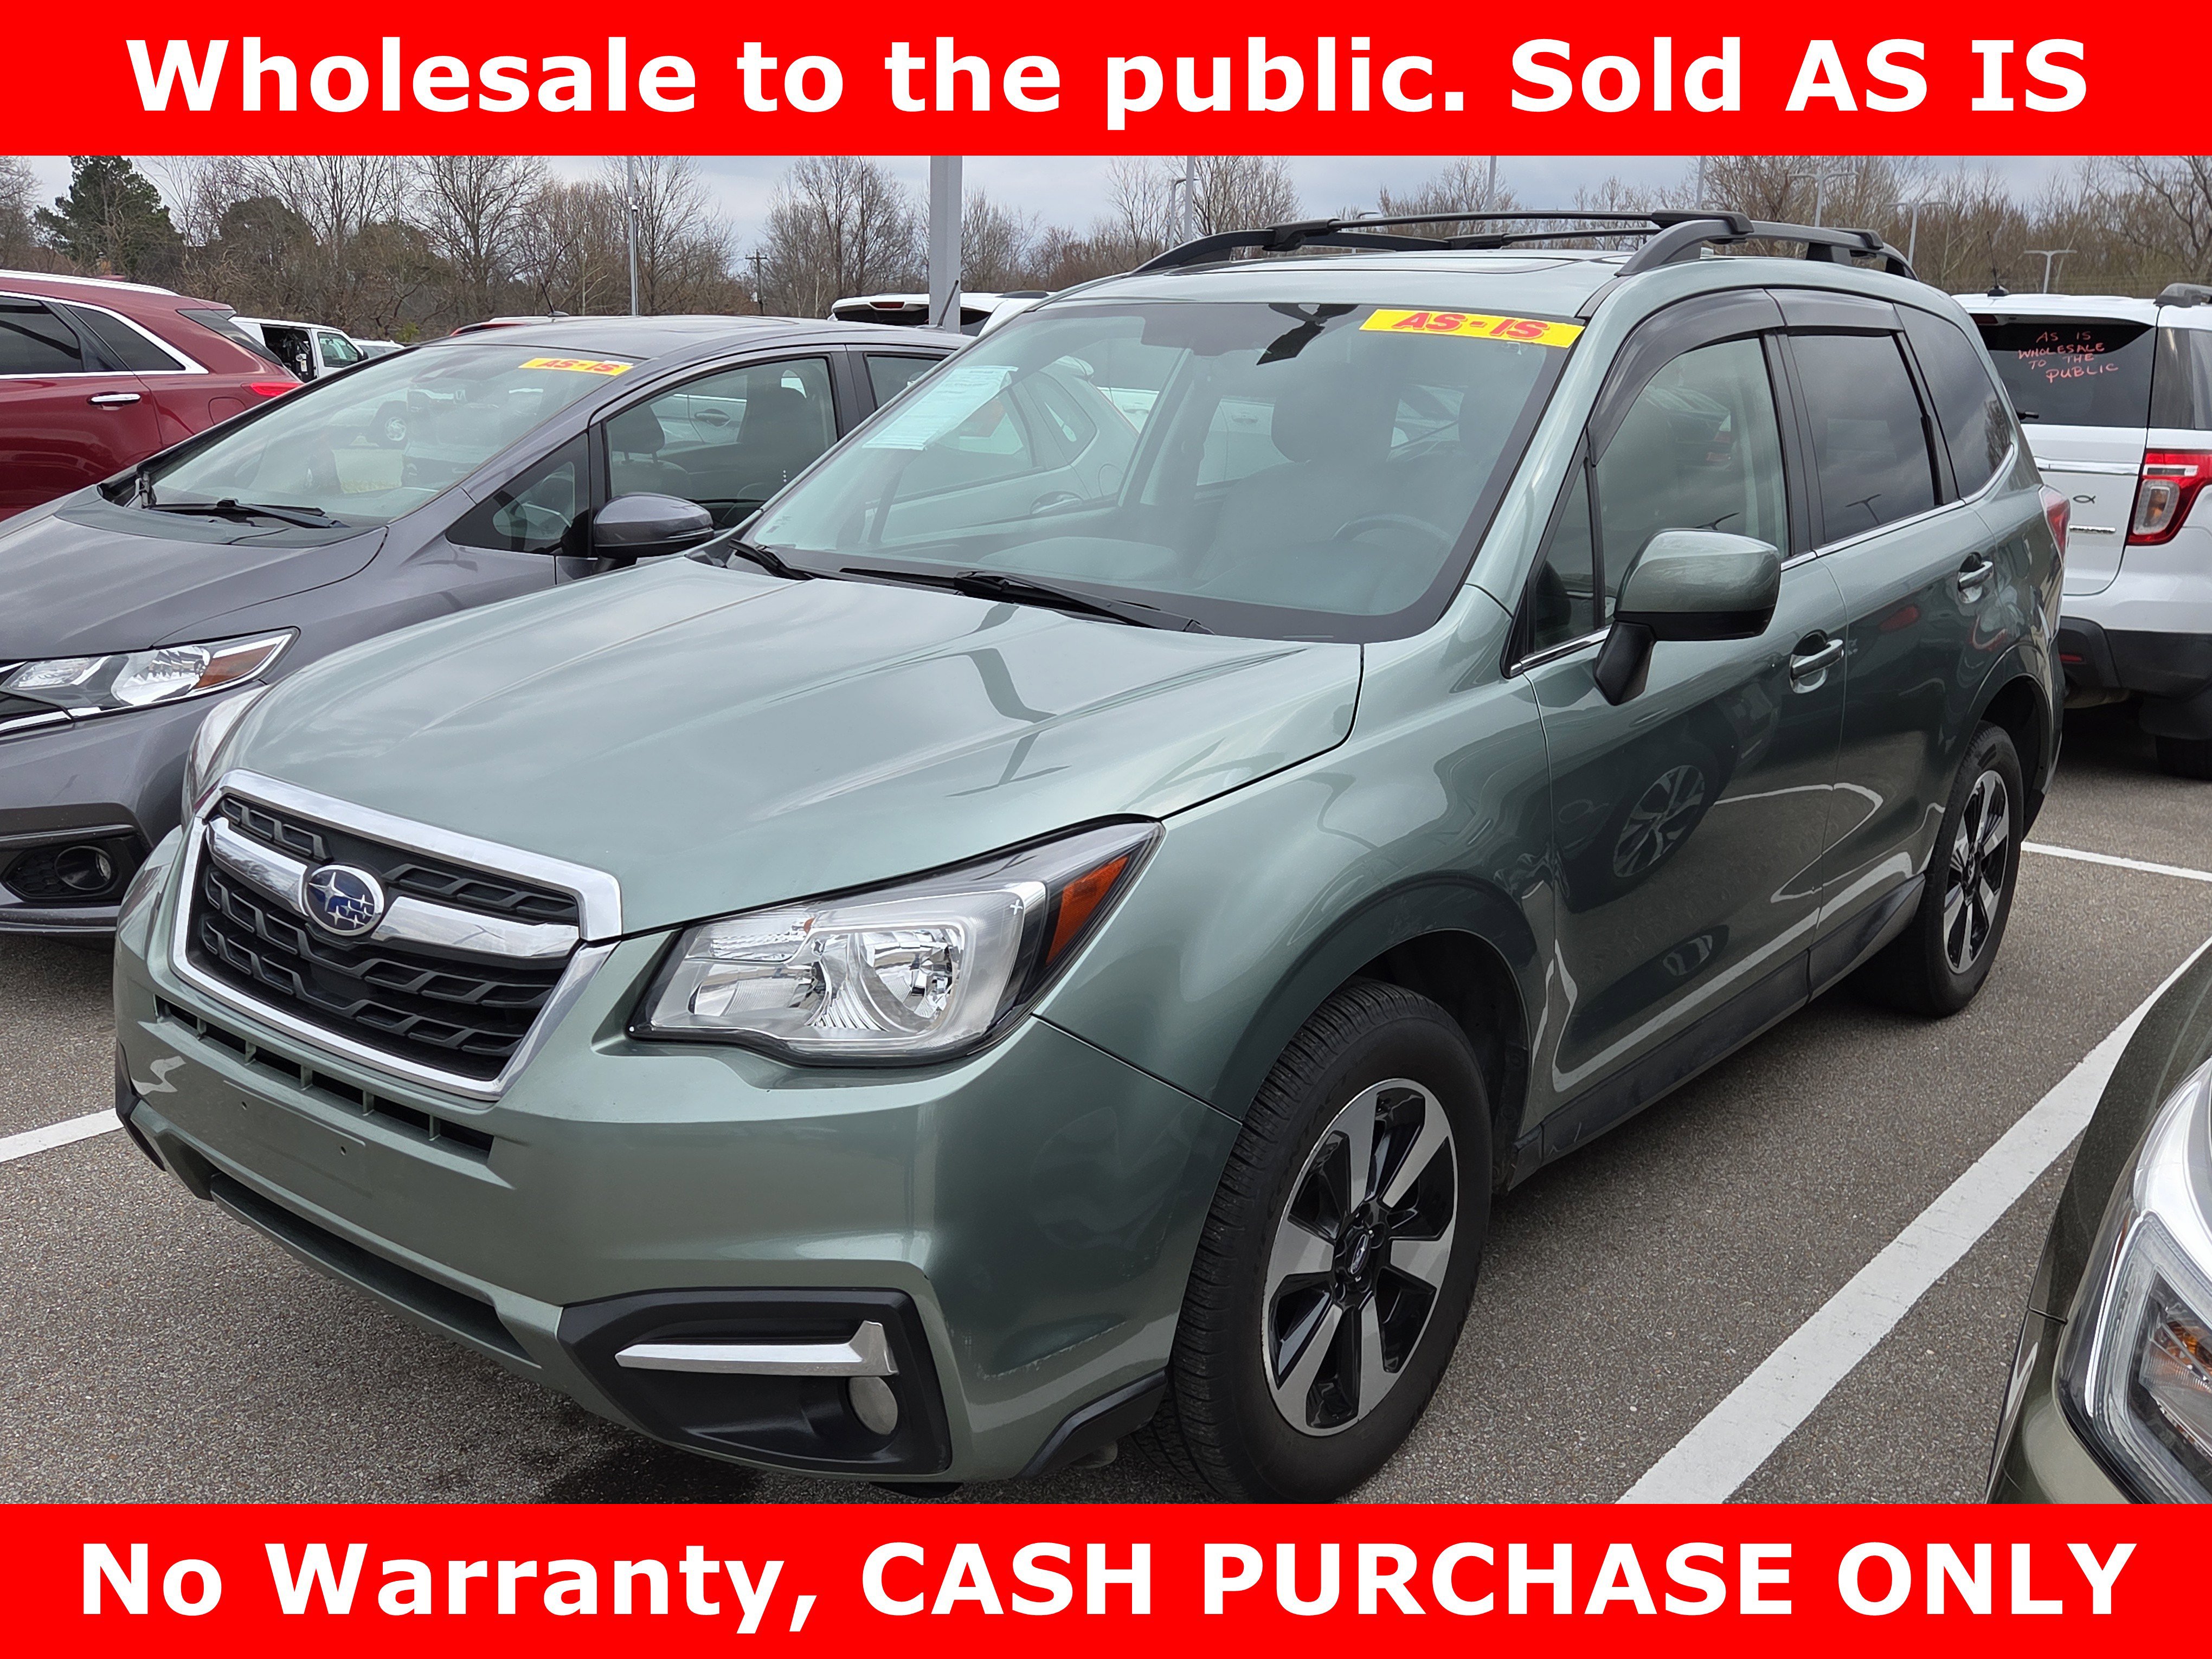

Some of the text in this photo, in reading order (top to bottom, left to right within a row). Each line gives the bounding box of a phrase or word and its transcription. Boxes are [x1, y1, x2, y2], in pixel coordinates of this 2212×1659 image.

[1391, 312, 1550, 339] AS-IS
[2036, 331, 2091, 342] AS IS
[2018, 343, 2105, 359] WHOLESALE
[2028, 352, 2094, 370] TO THE
[2045, 363, 2119, 383] PUBLIC
